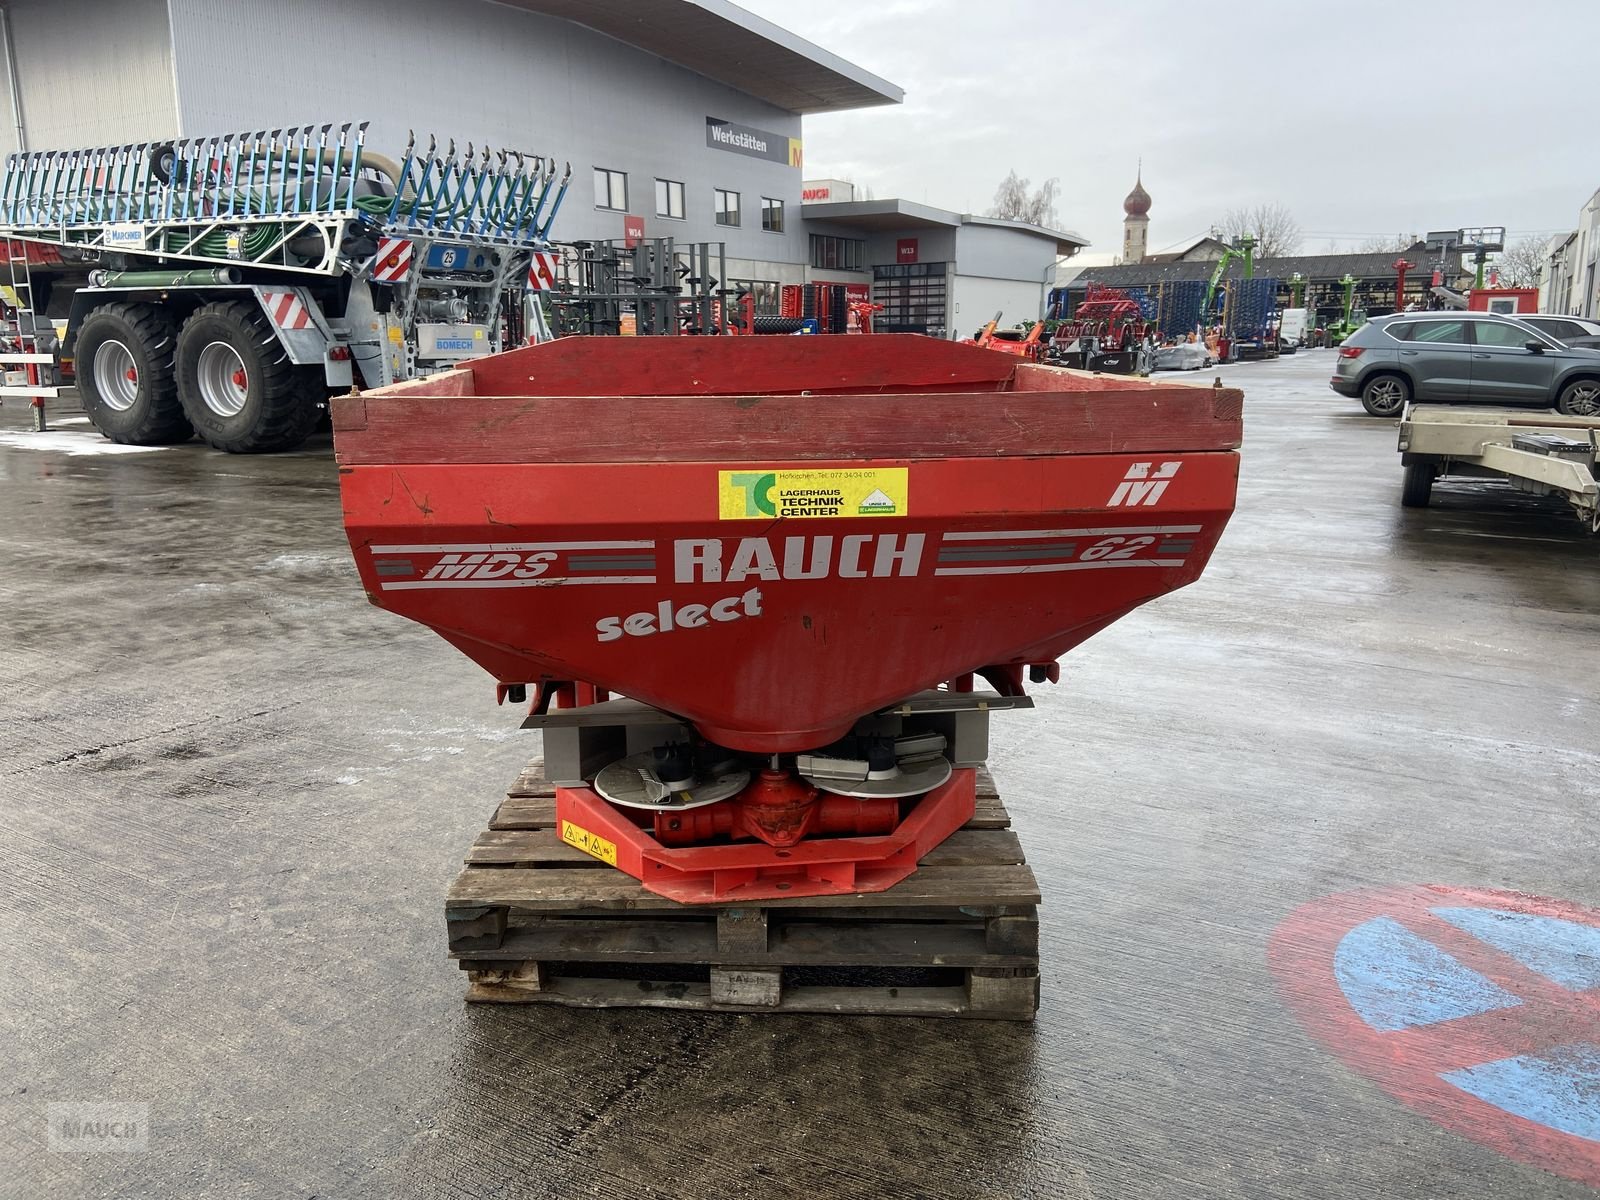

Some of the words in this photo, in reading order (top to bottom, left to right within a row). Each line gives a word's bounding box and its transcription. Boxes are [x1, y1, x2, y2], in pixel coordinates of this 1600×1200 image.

[711, 125, 767, 152] Werkstätten
[802, 188, 829, 200] AUCH
[901, 247, 914, 255] W13
[444, 252, 454, 264] 25
[436, 341, 473, 350] BOMECH
[780, 489, 841, 497] LAGERHAUS
[780, 497, 845, 507] TECHNIK
[780, 507, 839, 517] CENTER
[1079, 535, 1156, 561] 62
[673, 533, 926, 584] RAUCH
[422, 551, 559, 580] MDS
[595, 586, 763, 642] select
